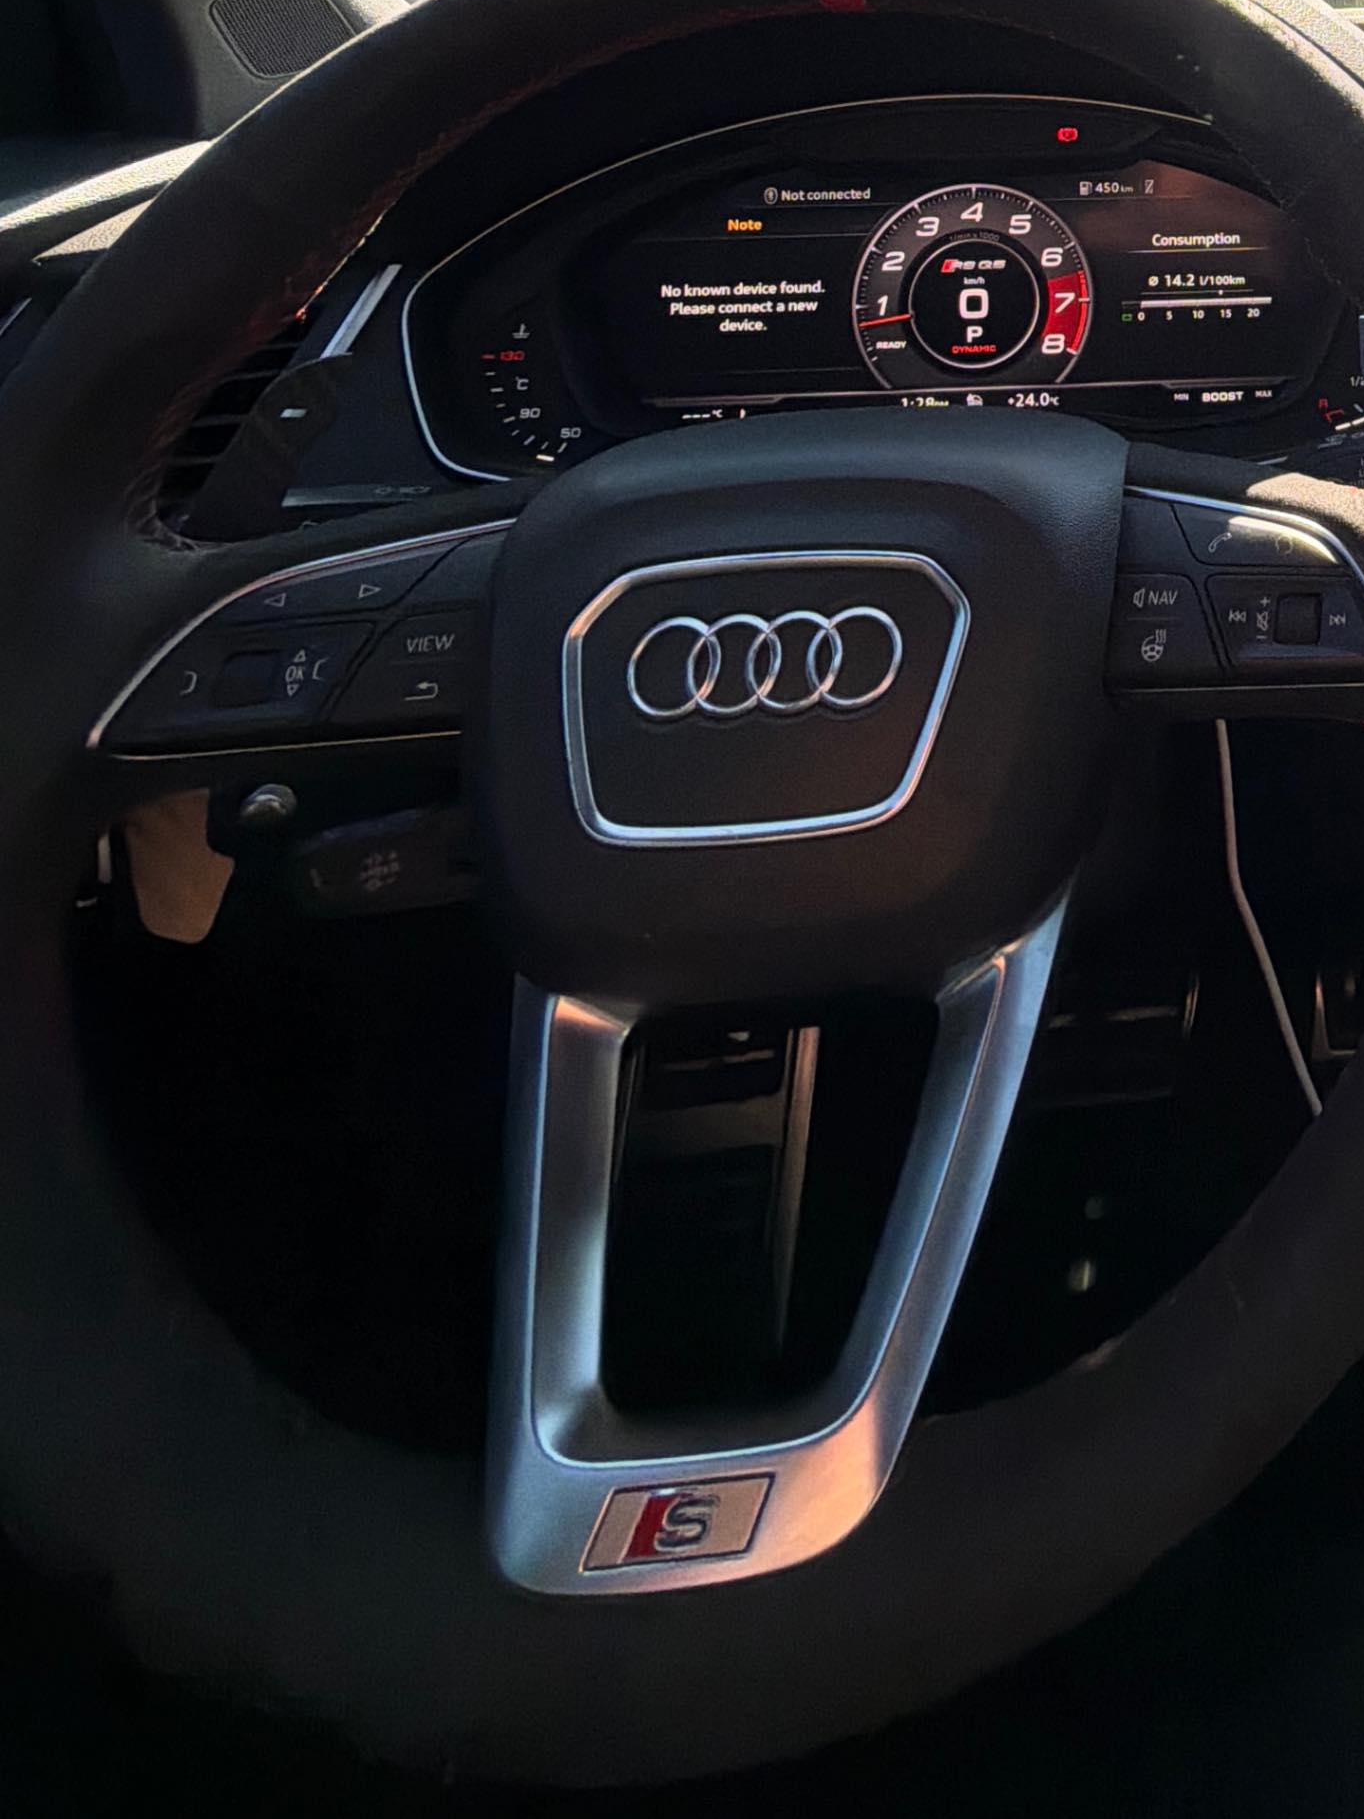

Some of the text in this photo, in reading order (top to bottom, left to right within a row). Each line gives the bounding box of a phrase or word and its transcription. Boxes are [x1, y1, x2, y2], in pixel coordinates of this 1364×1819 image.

[781, 188, 871, 201] Not connected
[960, 202, 984, 223] 4
[727, 219, 762, 231] Note
[915, 216, 940, 236] 3
[1008, 214, 1032, 235] 5
[1152, 233, 1241, 248] Consumption
[881, 251, 905, 271] 2
[1040, 247, 1064, 267] 6
[1164, 274, 1195, 286] 14.2
[661, 280, 826, 297] No known device found.
[669, 300, 818, 315] Please connect a new
[877, 295, 889, 316] 1
[958, 288, 989, 319] 0
[1054, 292, 1076, 314] 7
[1137, 308, 1260, 321] 0 5 10 15 20
[719, 319, 767, 332] device.
[967, 326, 983, 343] P
[876, 341, 907, 350] READY
[952, 344, 997, 354] DYNAMIC
[1041, 333, 1065, 354] 8
[1174, 393, 1189, 401] MIN
[1202, 391, 1245, 402] BOOST
[1255, 389, 1272, 398] MAX
[519, 408, 541, 420] 90
[1148, 590, 1178, 605] NAV
[406, 634, 455, 654] VIEW
[654, 1494, 720, 1552] S
